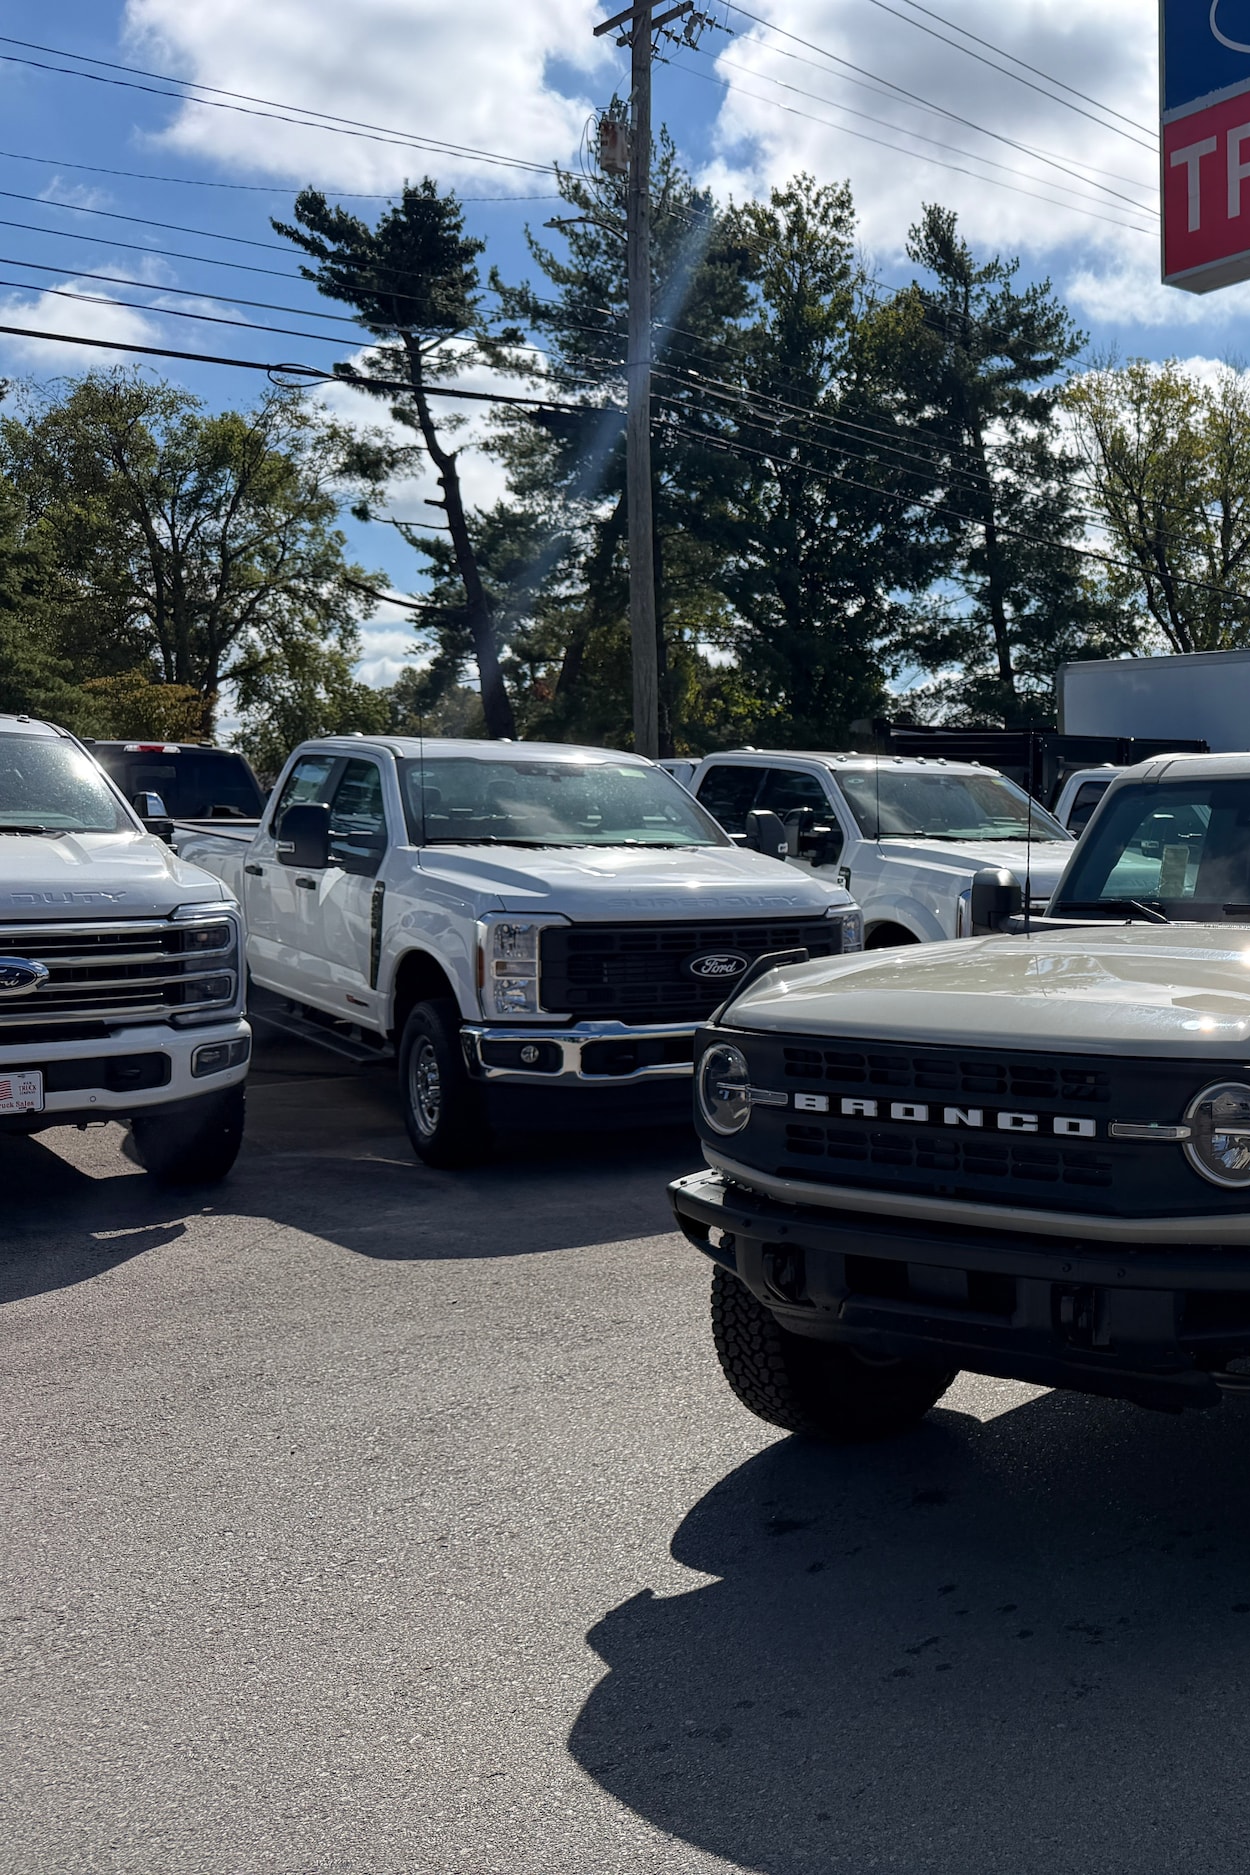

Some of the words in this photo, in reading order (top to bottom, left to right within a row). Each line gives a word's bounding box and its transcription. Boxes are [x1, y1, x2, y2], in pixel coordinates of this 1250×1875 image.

[11, 891, 127, 905] DUTY
[608, 898, 720, 909] SUPER
[724, 896, 798, 906] DUTY
[701, 957, 737, 974] Ford
[794, 1092, 1097, 1138] BRONCO
